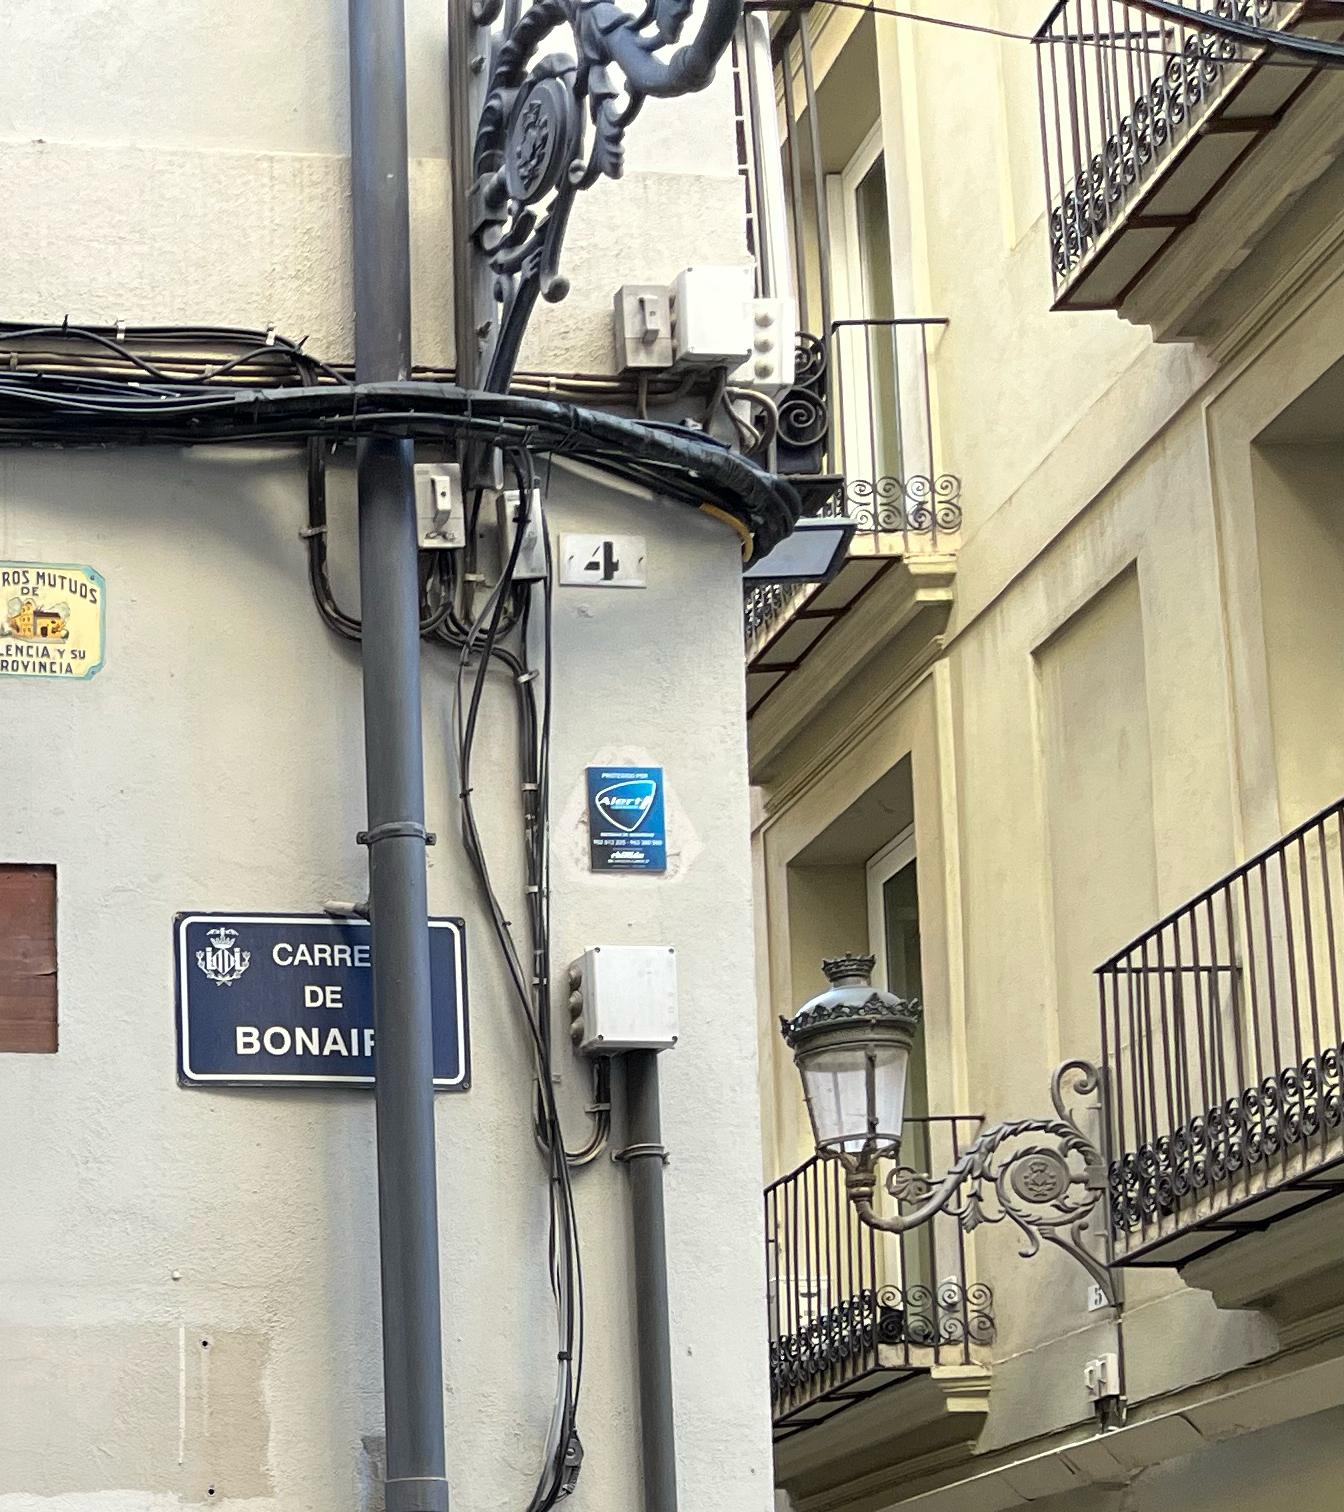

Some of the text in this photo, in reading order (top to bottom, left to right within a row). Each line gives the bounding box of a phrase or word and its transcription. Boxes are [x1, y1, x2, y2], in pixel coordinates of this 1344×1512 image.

[583, 541, 620, 581] 4
[20, 586, 40, 596] DE
[36, 571, 98, 604] MUTUOS
[56, 648, 66, 659] Y
[70, 649, 86, 660] SU
[272, 943, 371, 967] CARRE
[304, 986, 343, 1008] DE
[235, 1026, 375, 1056] BONAI
